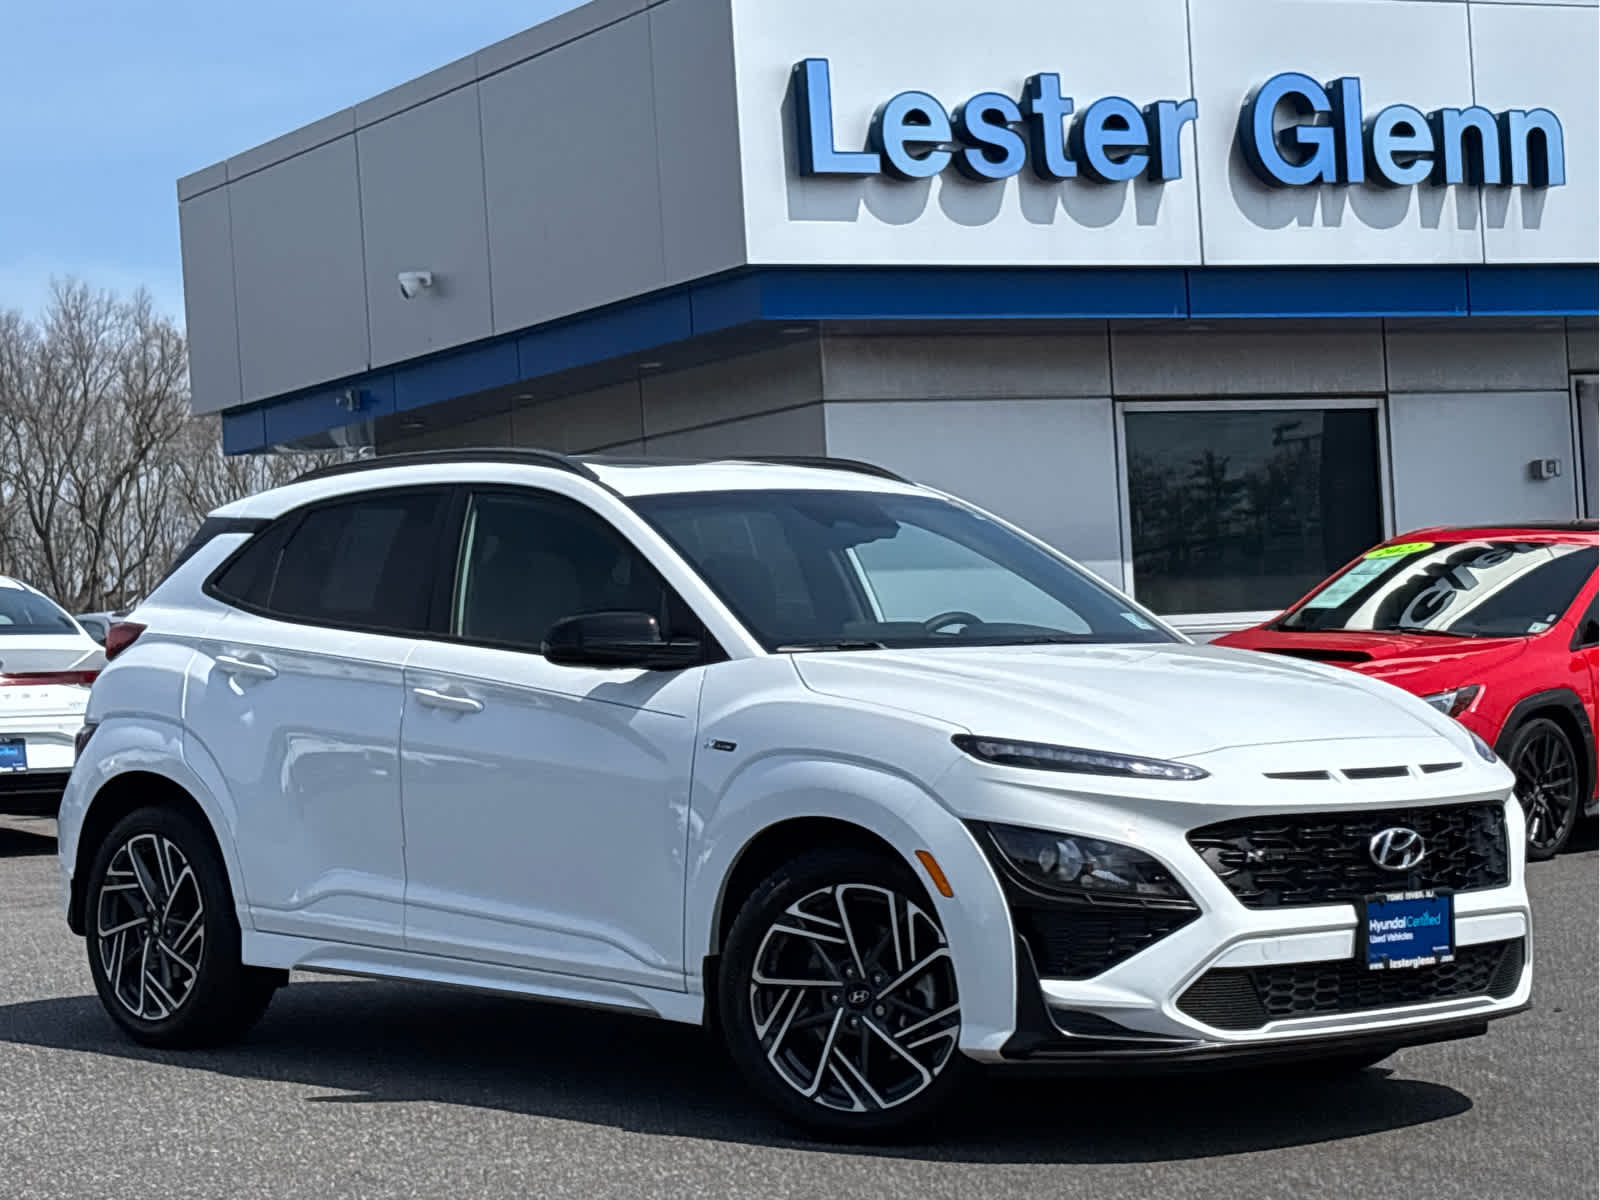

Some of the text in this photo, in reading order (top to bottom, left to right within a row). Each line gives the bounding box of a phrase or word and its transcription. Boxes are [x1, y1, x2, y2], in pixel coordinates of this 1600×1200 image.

[798, 58, 1566, 188] Lester Glenn
[1369, 934, 1387, 944] Used
